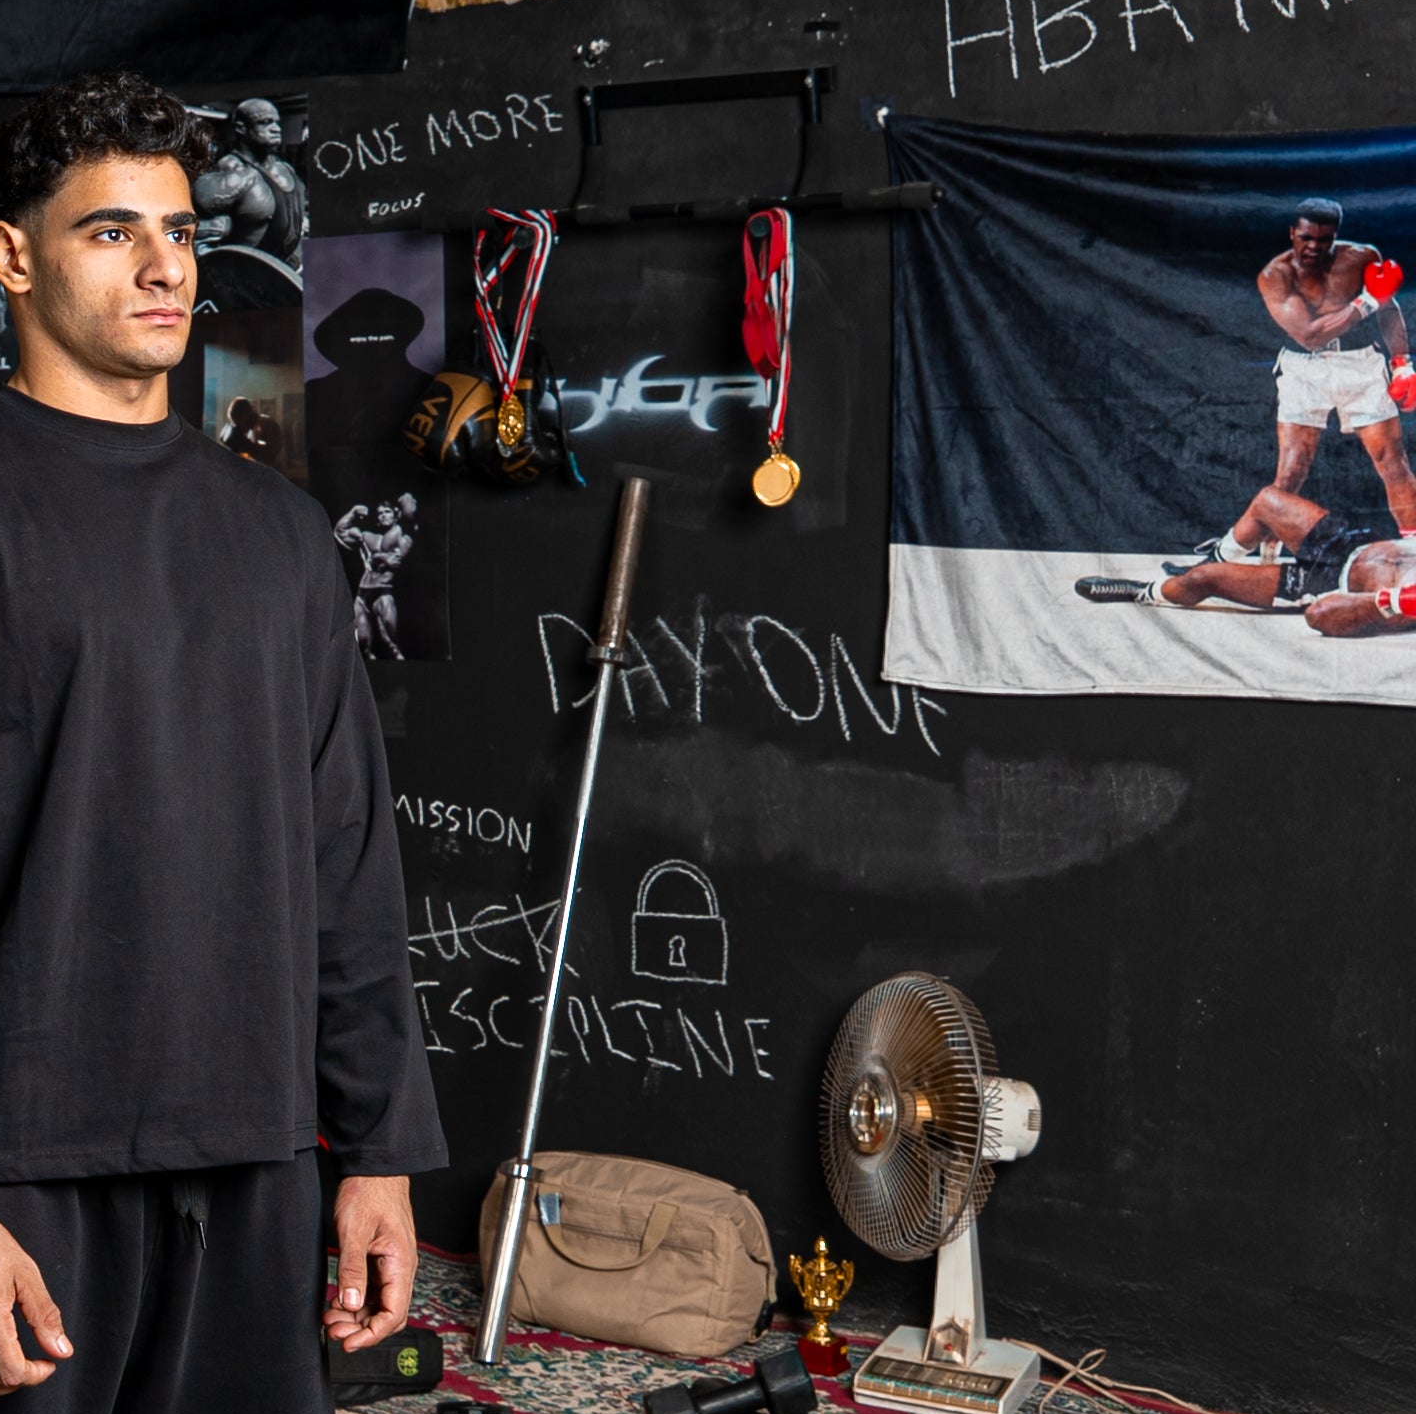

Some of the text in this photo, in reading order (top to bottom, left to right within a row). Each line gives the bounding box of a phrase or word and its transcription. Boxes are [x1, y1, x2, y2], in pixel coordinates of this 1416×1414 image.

[314, 93, 563, 179] ONE MORE
[368, 192, 425, 217] FOCUS
[538, 614, 707, 723] DAY
[407, 889, 581, 978] UCK
